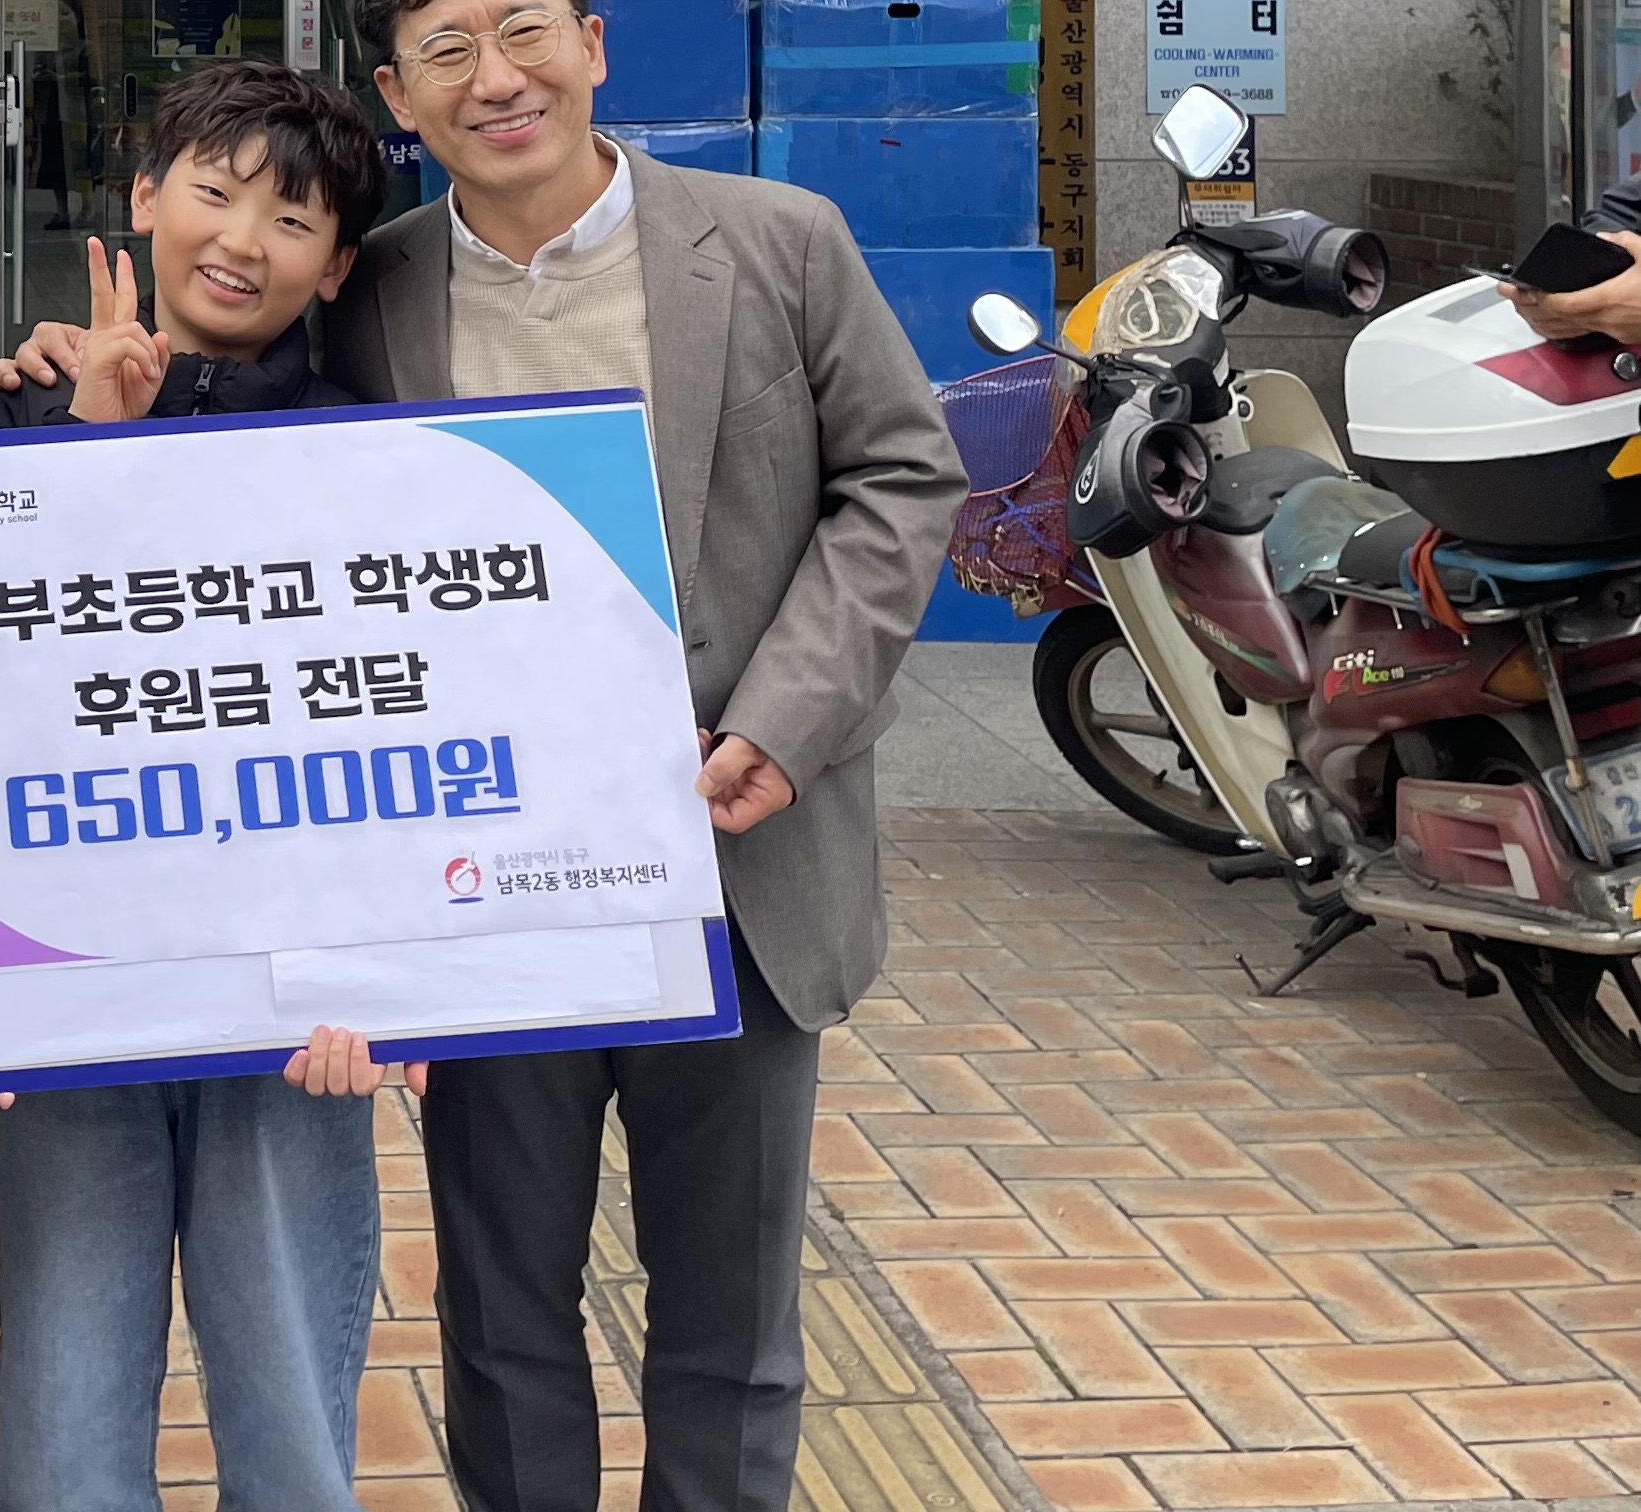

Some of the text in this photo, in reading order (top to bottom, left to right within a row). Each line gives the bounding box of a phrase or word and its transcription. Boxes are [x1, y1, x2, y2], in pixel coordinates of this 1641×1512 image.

[301, 0, 314, 50] 고정문
[1194, 65, 1241, 78] CENTER
[1060, 153, 1088, 272] 동구지회
[7, 513, 38, 524] school
[344, 541, 551, 614] 학생회
[73, 651, 429, 736] 후원금 전달
[1362, 666, 1390, 685] Ace
[5, 734, 522, 850] 650,000원
[493, 848, 590, 871] 울산광역시 동구
[496, 861, 669, 896] 남목2동 행정복지센터
